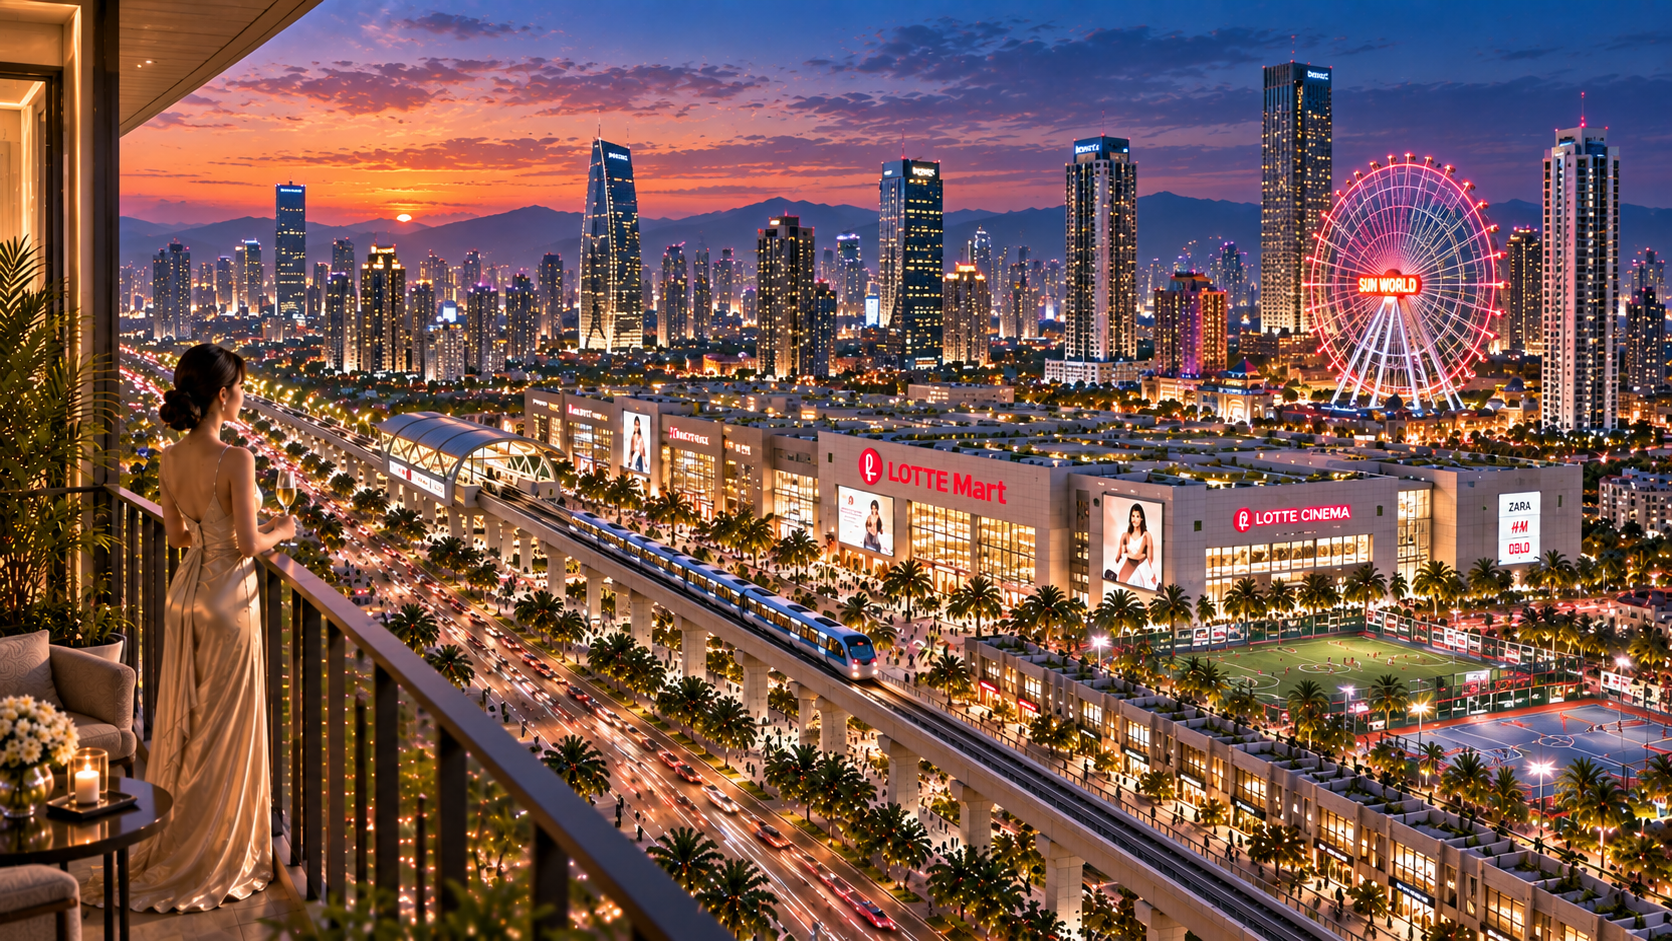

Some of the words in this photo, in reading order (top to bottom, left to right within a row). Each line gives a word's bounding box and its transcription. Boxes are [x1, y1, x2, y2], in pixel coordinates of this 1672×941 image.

[1359, 277, 1378, 293] SUN
[1379, 277, 1417, 293] WORLD
[888, 461, 948, 493] LOTTE
[953, 472, 1007, 505] Mart
[1508, 501, 1531, 512] ZARA
[1256, 511, 1298, 526] LOTTE
[1301, 506, 1351, 521] CINEMA
